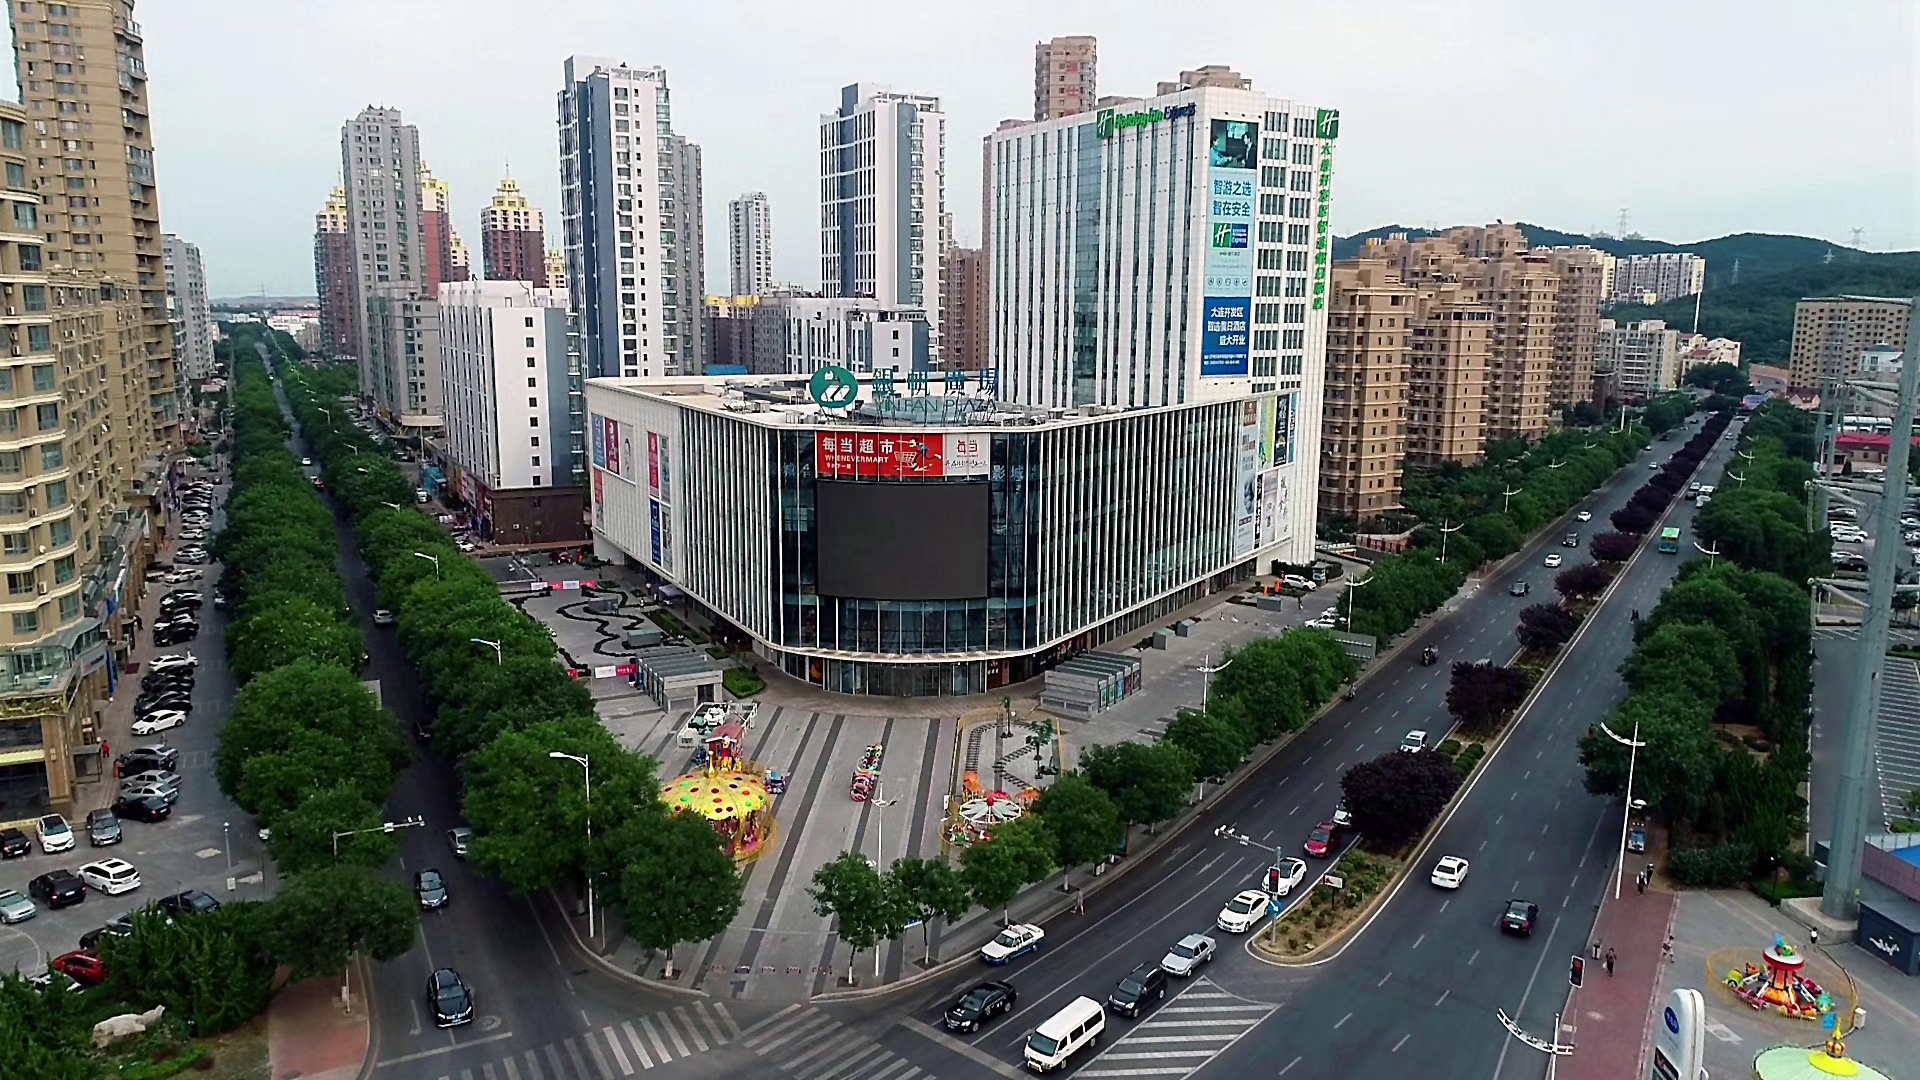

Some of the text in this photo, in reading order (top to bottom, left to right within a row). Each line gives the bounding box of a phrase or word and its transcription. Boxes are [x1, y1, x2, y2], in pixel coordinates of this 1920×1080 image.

[1115, 111, 1147, 128] Holiday
[1148, 107, 1163, 123] Inn
[1213, 179, 1252, 197] 智游之选
[1212, 199, 1251, 217] 智在安全
[1210, 306, 1244, 318] 大连开发区
[822, 437, 895, 454] 每当超市
[825, 454, 889, 463] WHENEVERMART
